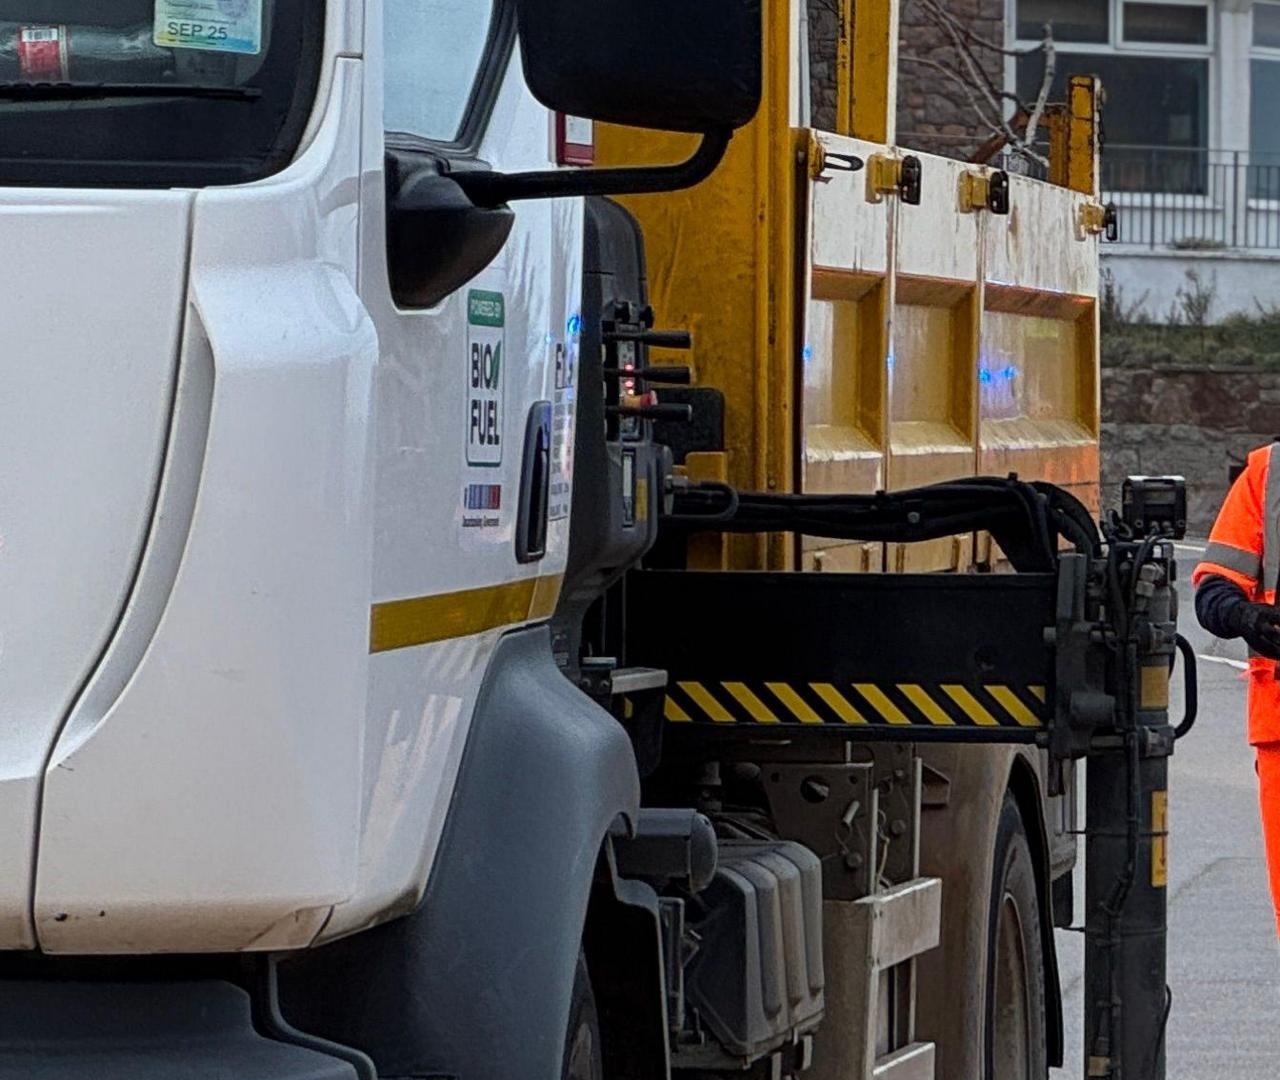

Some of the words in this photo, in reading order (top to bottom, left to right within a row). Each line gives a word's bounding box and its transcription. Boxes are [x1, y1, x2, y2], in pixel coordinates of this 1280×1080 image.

[168, 22, 203, 37] SEP
[208, 26, 228, 40] 25
[472, 342, 492, 389] BIO
[470, 399, 499, 445] FUEL
